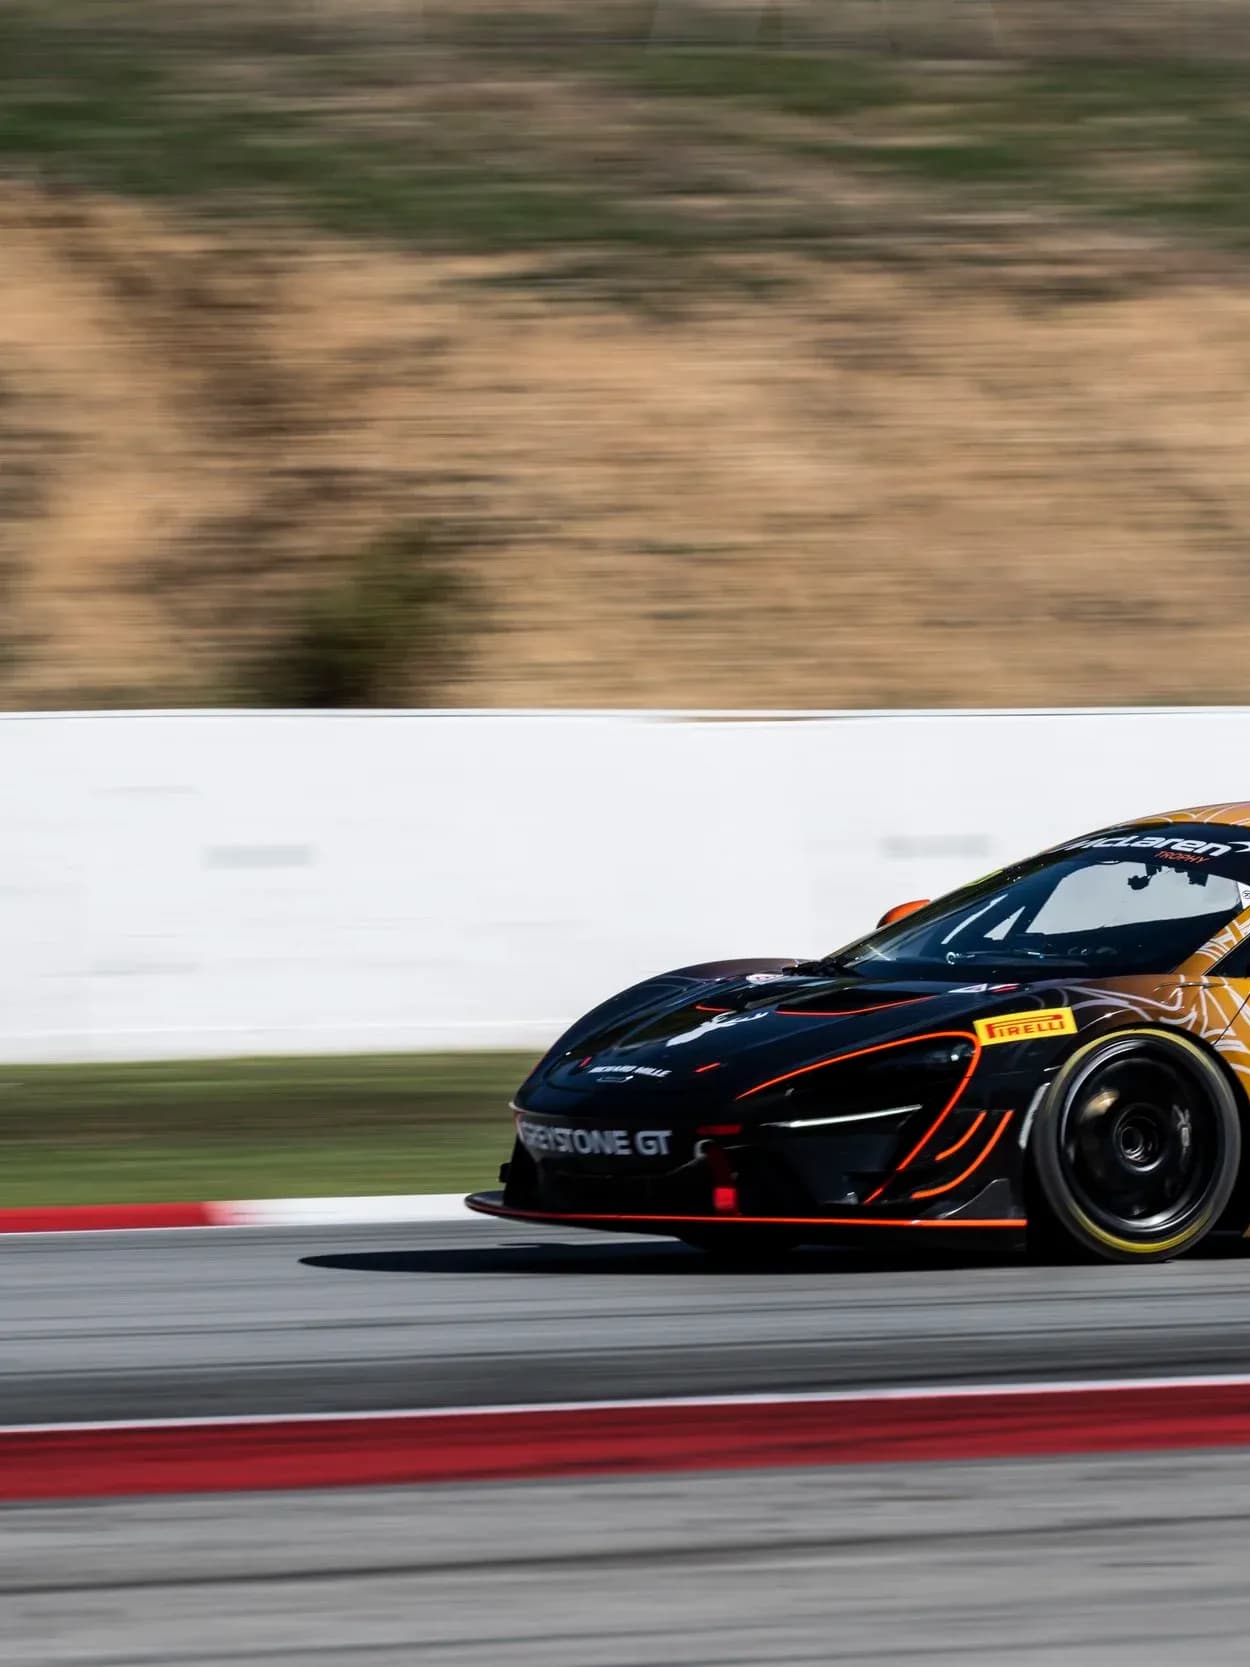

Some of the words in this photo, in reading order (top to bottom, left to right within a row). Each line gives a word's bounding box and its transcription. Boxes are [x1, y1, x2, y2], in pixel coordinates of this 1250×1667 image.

[1155, 850, 1210, 864] TROPHY
[986, 1013, 1065, 1039] PIRELLI
[634, 1130, 673, 1156] GT
